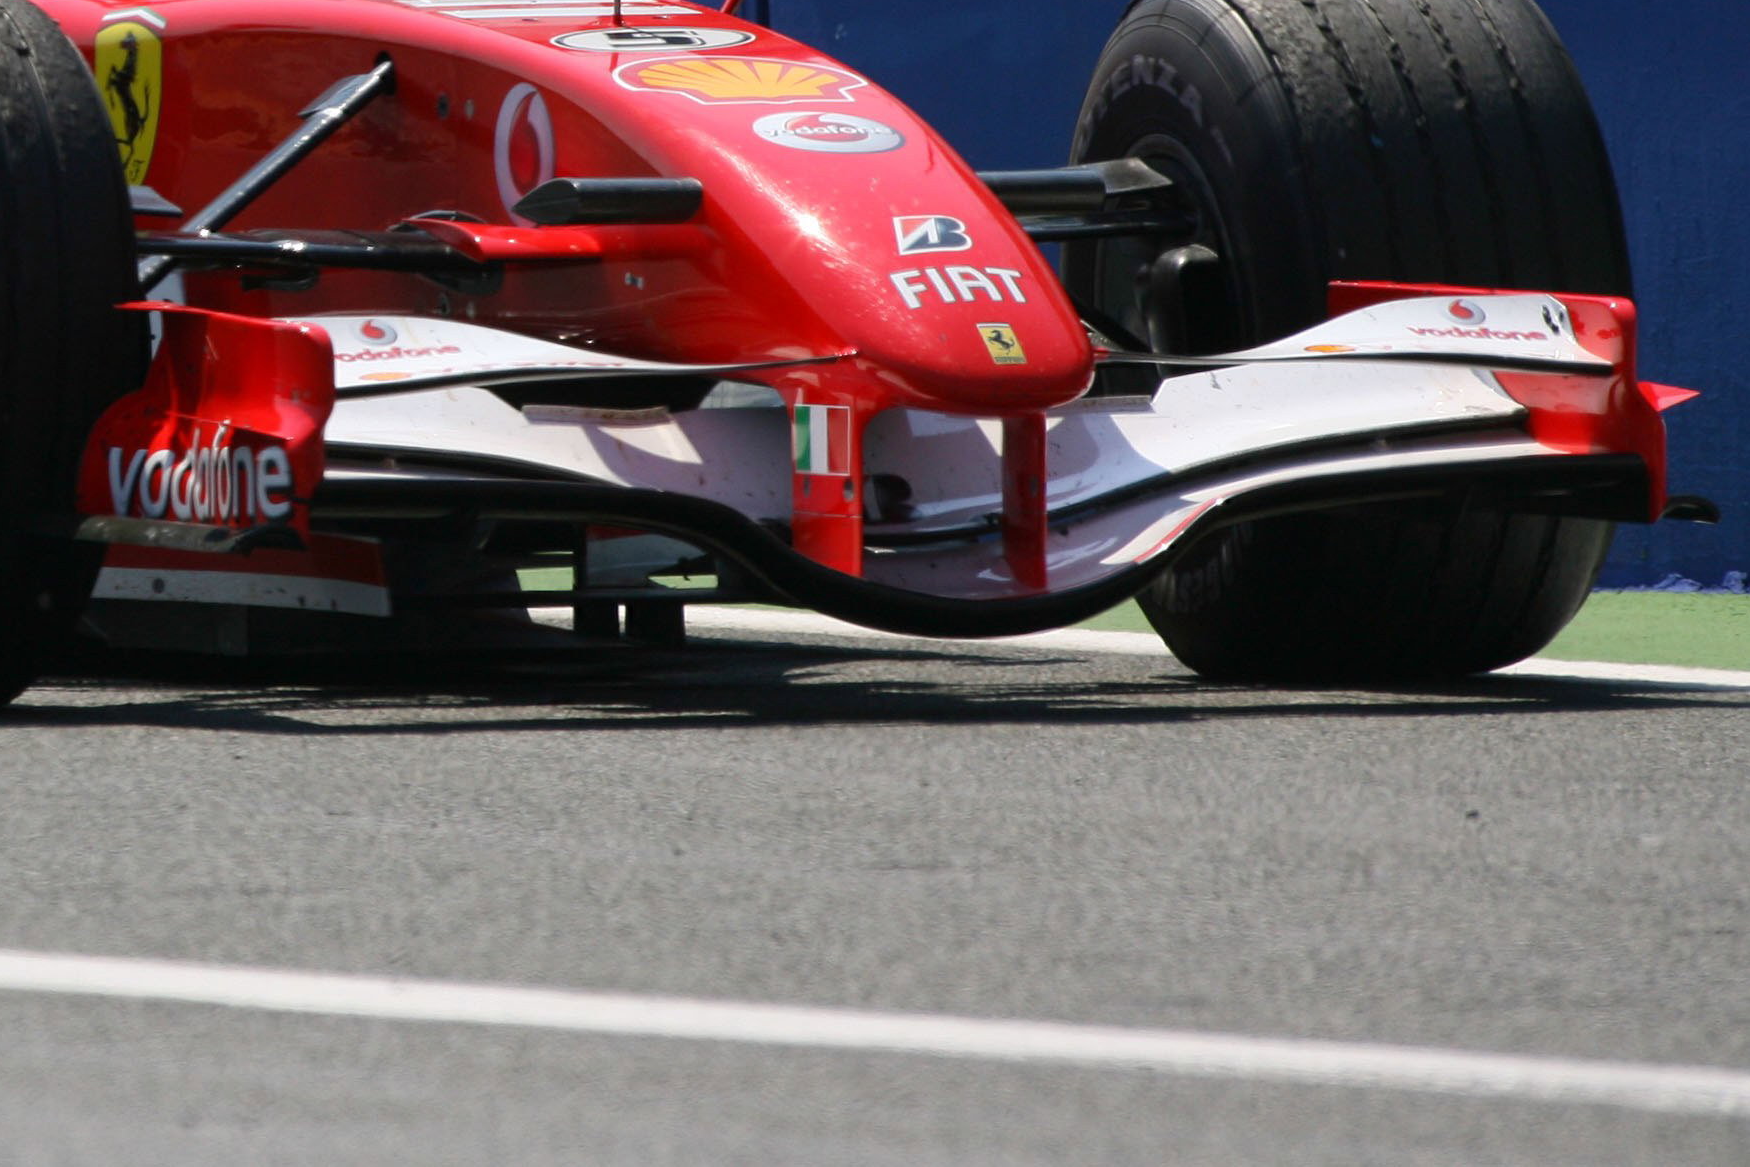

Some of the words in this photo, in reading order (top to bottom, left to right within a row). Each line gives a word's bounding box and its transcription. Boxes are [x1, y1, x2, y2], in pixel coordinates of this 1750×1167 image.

[890, 266, 1026, 309] FIAT
[1407, 327, 1547, 341] vodafone
[335, 345, 460, 363] odafone
[108, 419, 293, 521] vodafone
